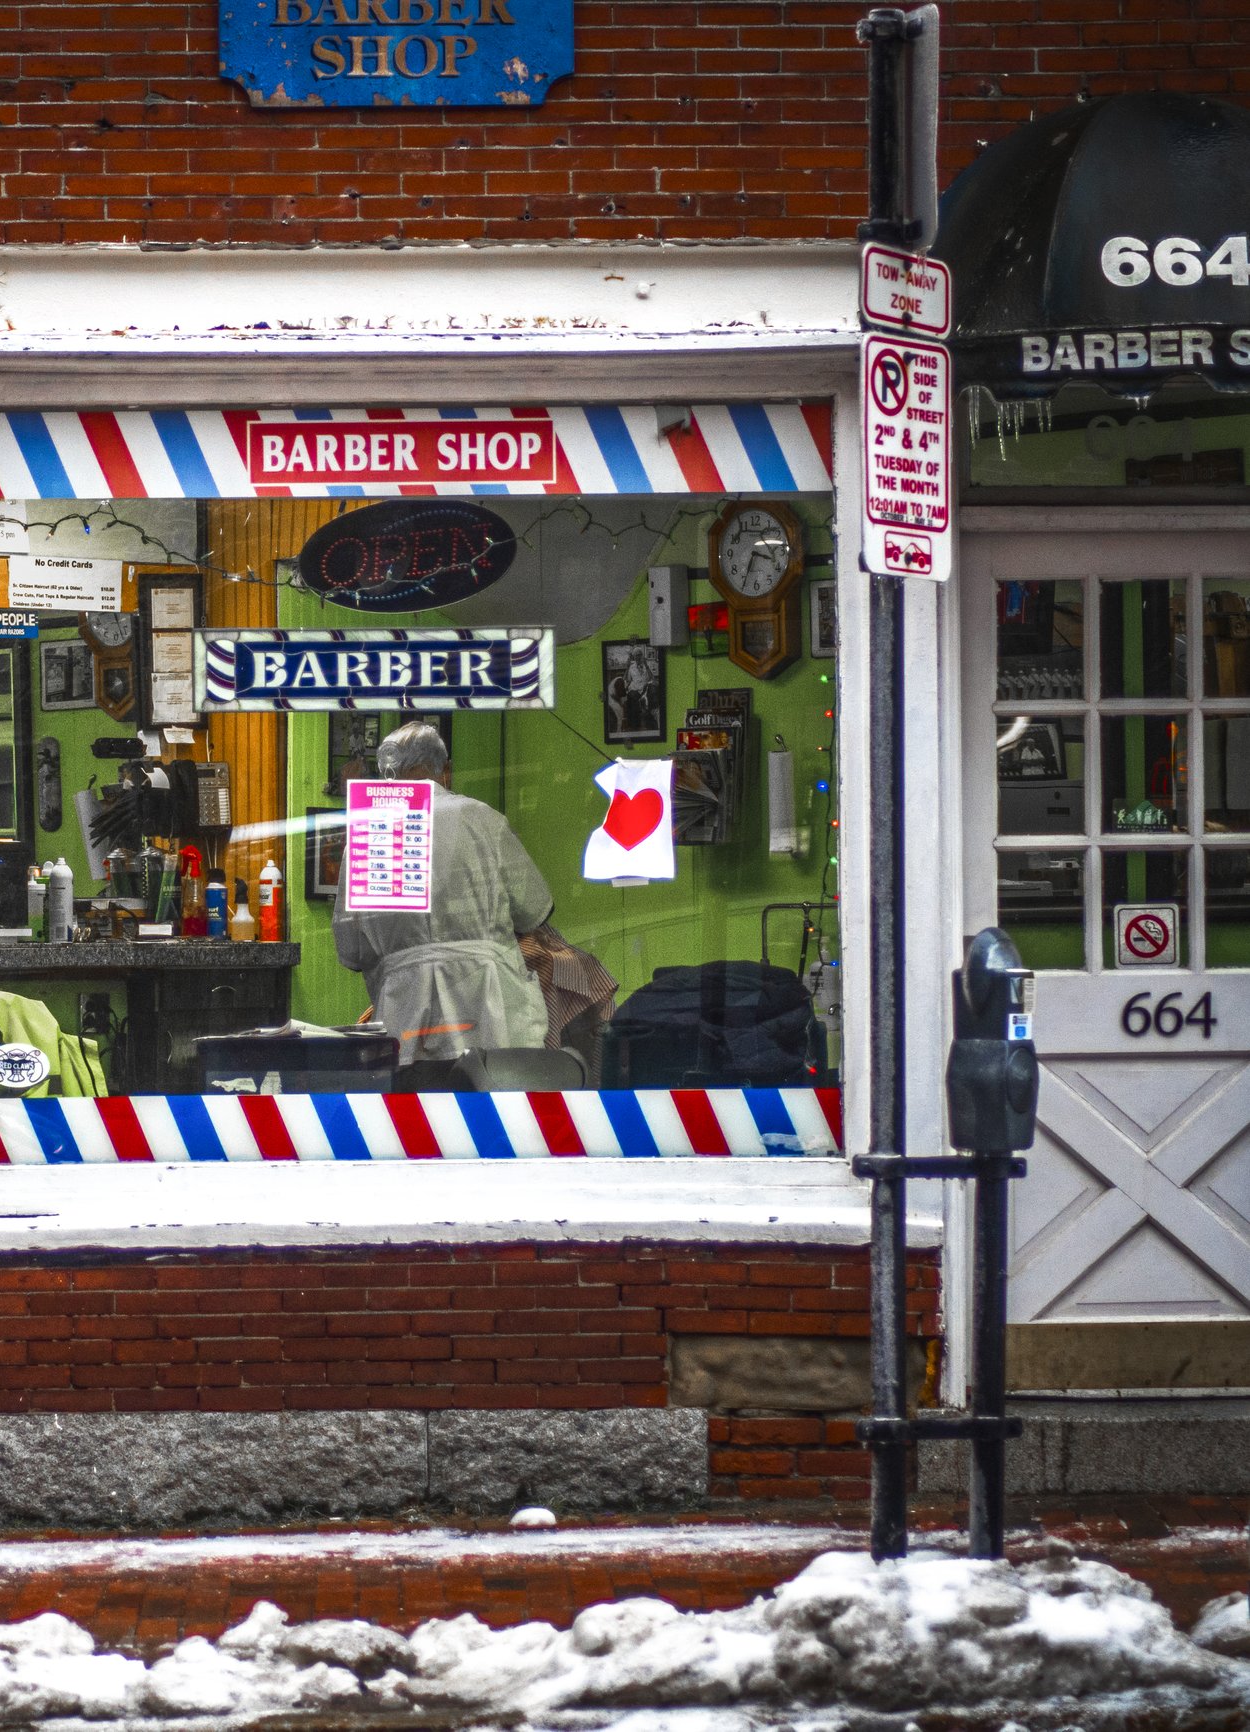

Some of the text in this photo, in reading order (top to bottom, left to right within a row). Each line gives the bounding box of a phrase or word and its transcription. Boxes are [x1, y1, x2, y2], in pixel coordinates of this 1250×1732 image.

[311, 35, 478, 78] SHOP
[1101, 236, 1250, 287] 664
[876, 262, 938, 291] TOW-AWAY
[891, 293, 922, 314] ZONE
[914, 354, 938, 369] THIS
[1021, 329, 1214, 372] BARBER
[913, 372, 938, 387] SIDE
[918, 391, 932, 404] OF
[906, 407, 944, 424] STREET
[902, 428, 913, 449] &
[918, 431, 939, 452] 4TH
[261, 432, 541, 473] BARBER SHOP
[874, 454, 939, 476] TUESDAY OF
[876, 475, 939, 497] THE MONTH
[870, 497, 945, 520] 12:01AM TO 7AM
[48, 560, 70, 568] Credit
[72, 560, 93, 569] Cards
[321, 522, 492, 586] OPEN
[252, 651, 494, 687] BARBER
[366, 786, 414, 797] BUSINESS
[1121, 992, 1217, 1038] 664
[13, 1061, 34, 1070] CLAWS
